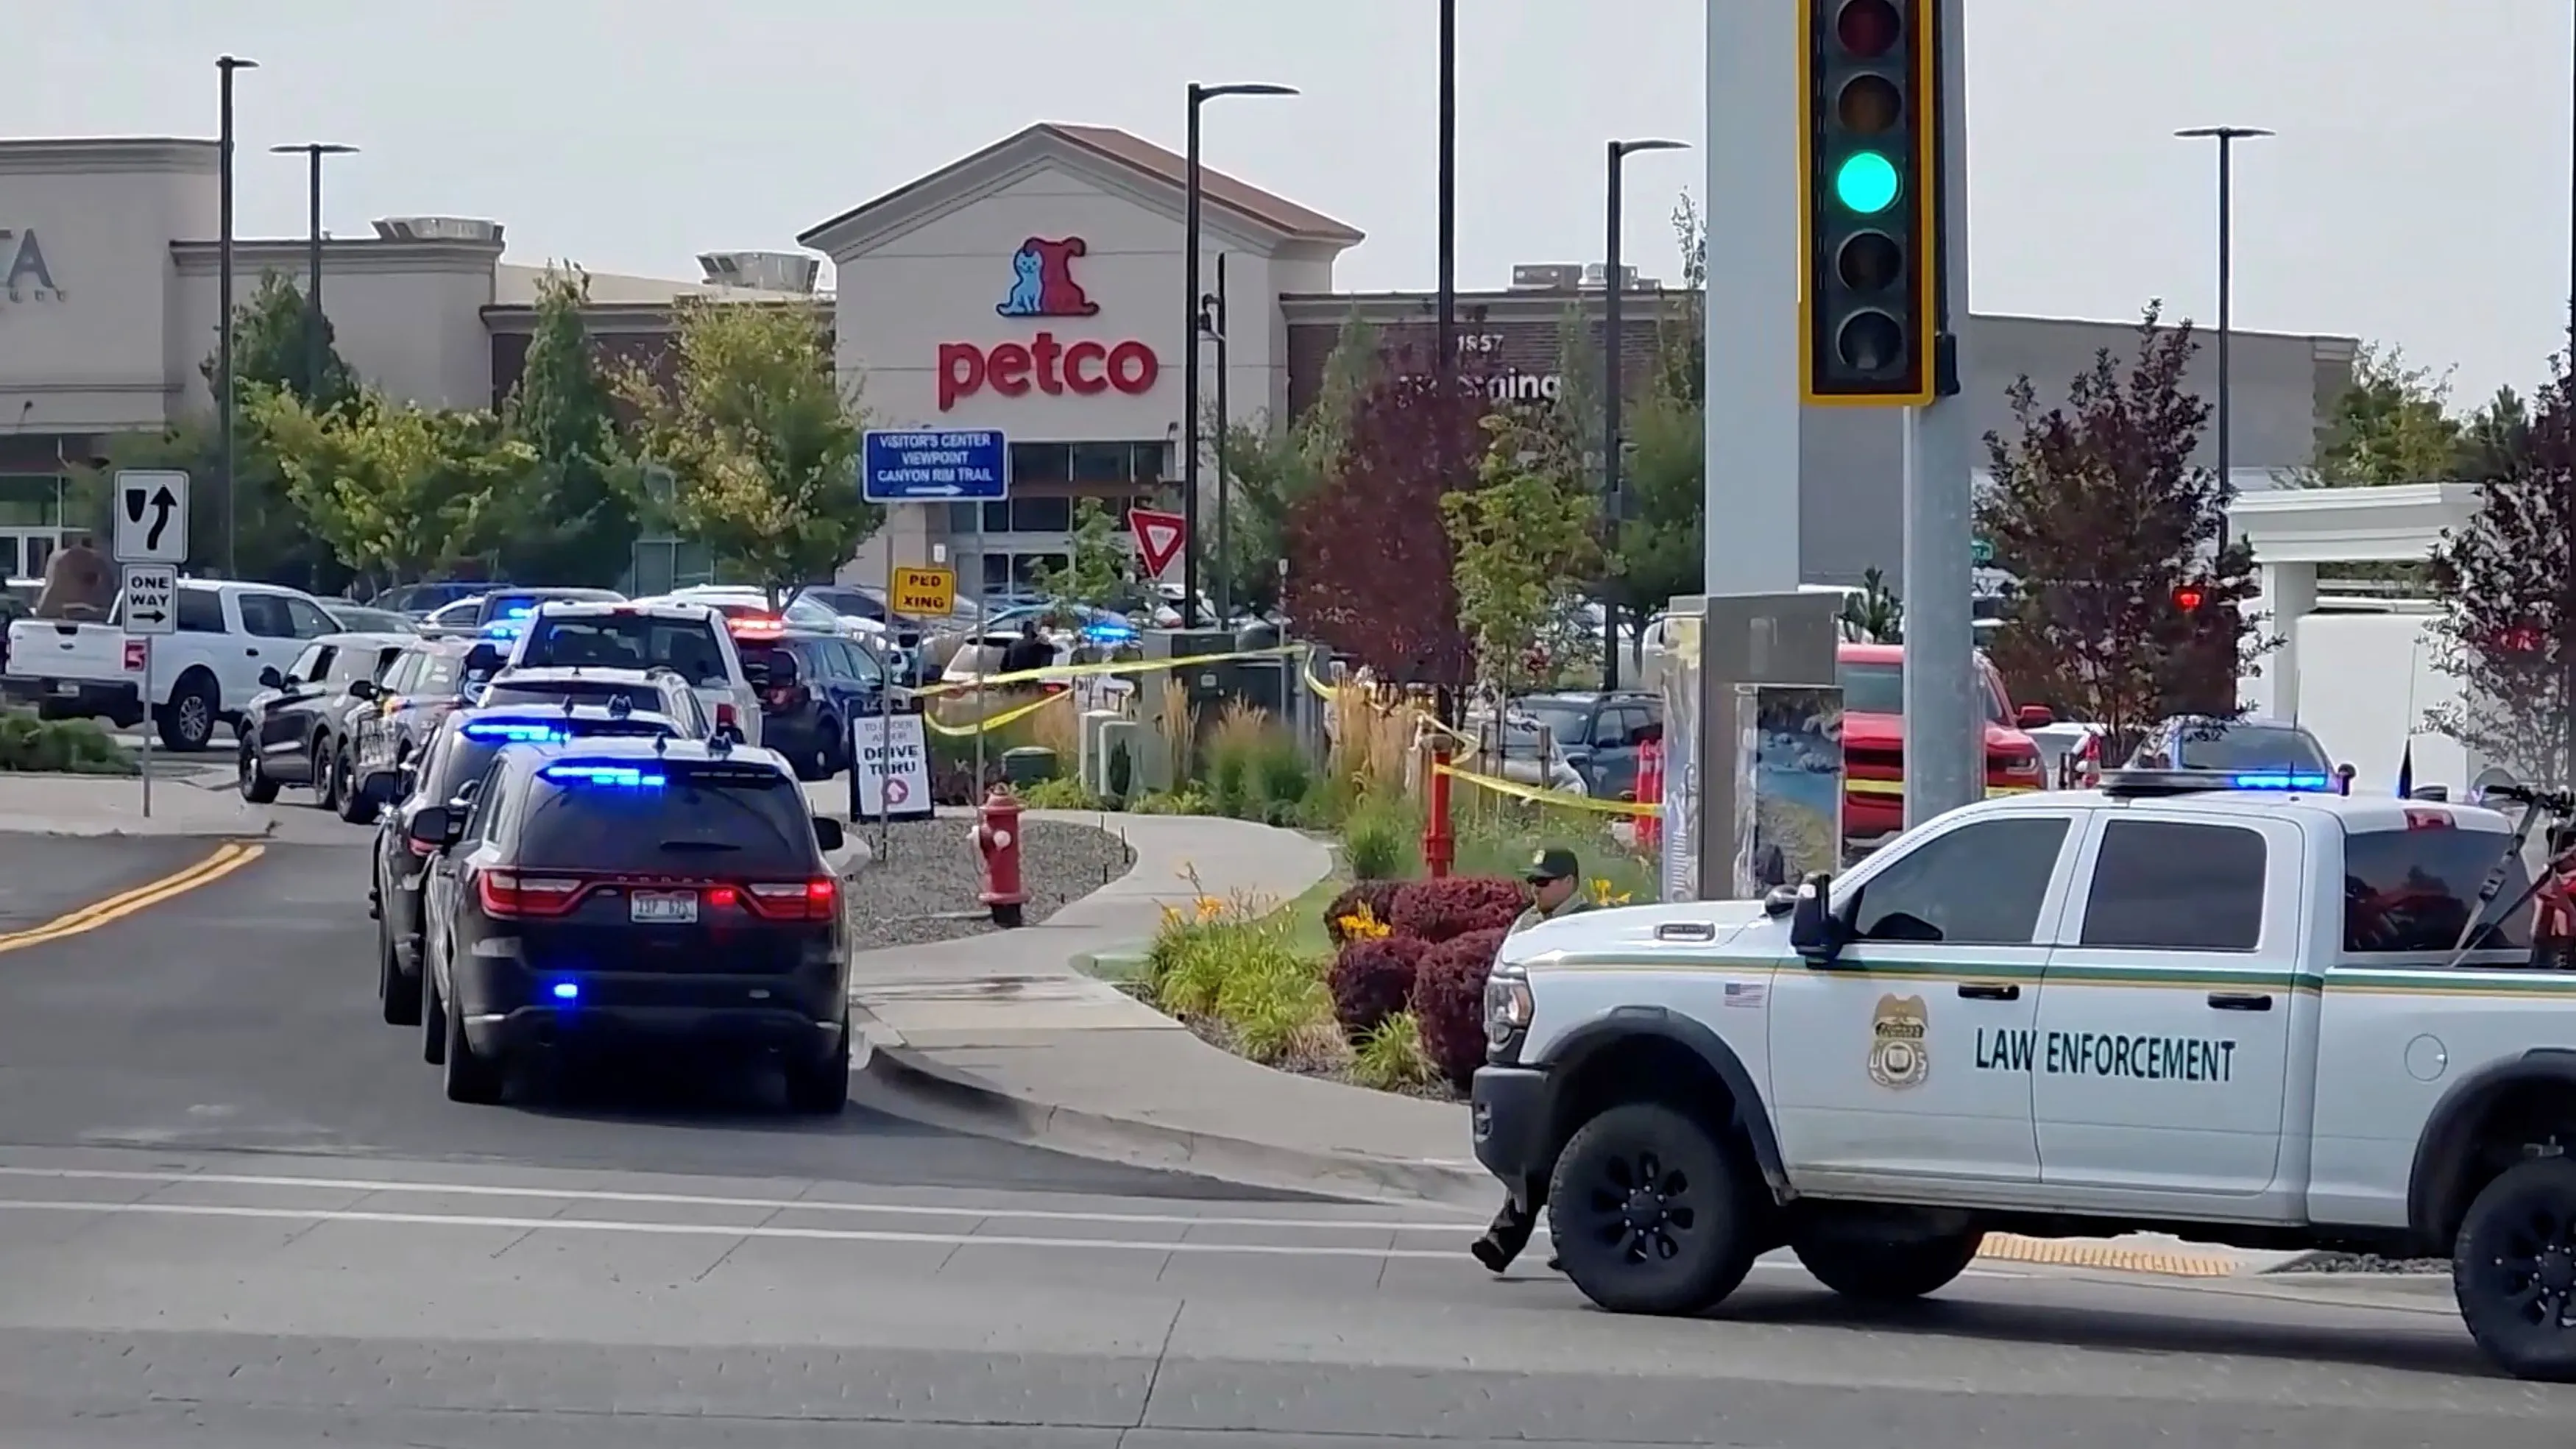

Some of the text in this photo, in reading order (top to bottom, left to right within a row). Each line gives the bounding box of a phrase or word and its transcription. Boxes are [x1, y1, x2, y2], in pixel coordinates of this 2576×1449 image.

[938, 332, 1158, 412] petco
[879, 433, 991, 449] VISITOR'S CENTER
[901, 450, 970, 465] VIEWPOINT
[877, 467, 994, 482] CANYON RIM TRAIL
[131, 575, 170, 589] ONE
[909, 575, 941, 587] PED
[130, 594, 169, 607] WAY
[904, 595, 945, 609] XING
[1975, 1027, 2237, 1082] LAW ENFORCEMENT
